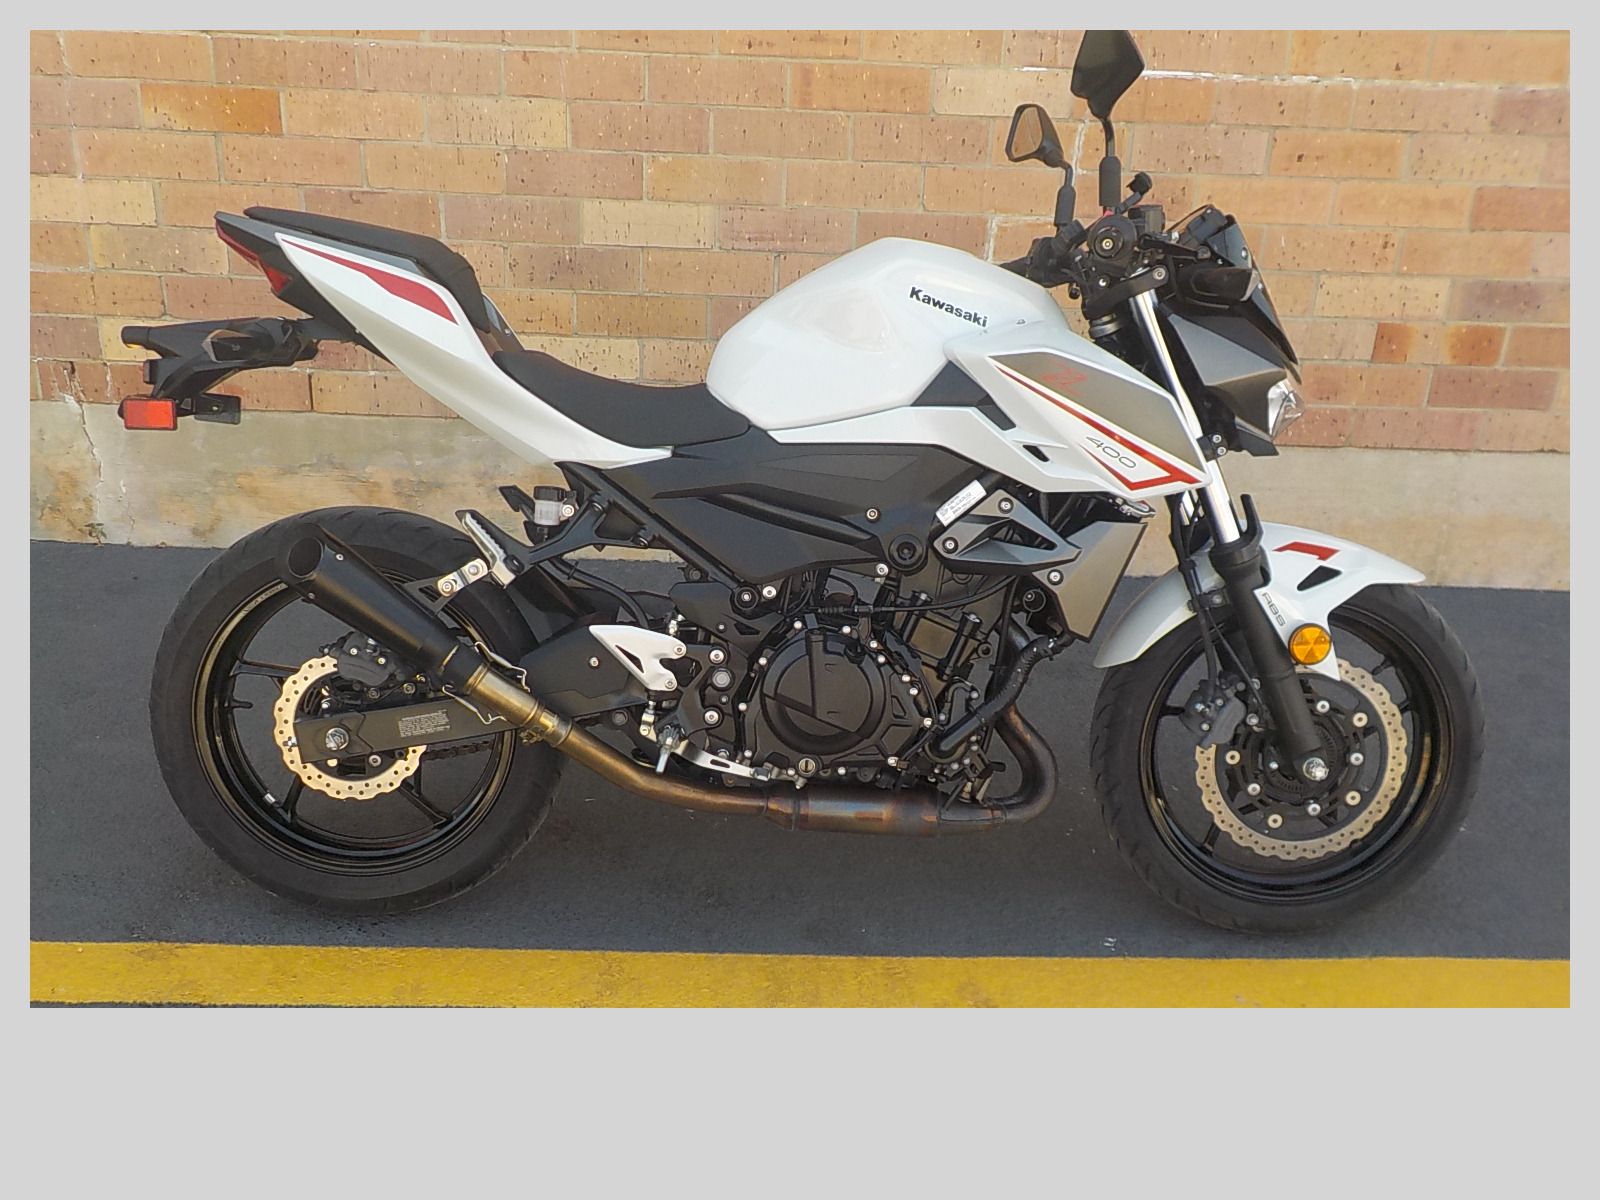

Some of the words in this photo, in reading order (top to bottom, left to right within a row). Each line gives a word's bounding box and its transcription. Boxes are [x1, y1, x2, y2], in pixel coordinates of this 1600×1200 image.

[909, 286, 988, 328] Kawasaki
[1086, 436, 1137, 469] 400
[1261, 592, 1286, 627] ABS
